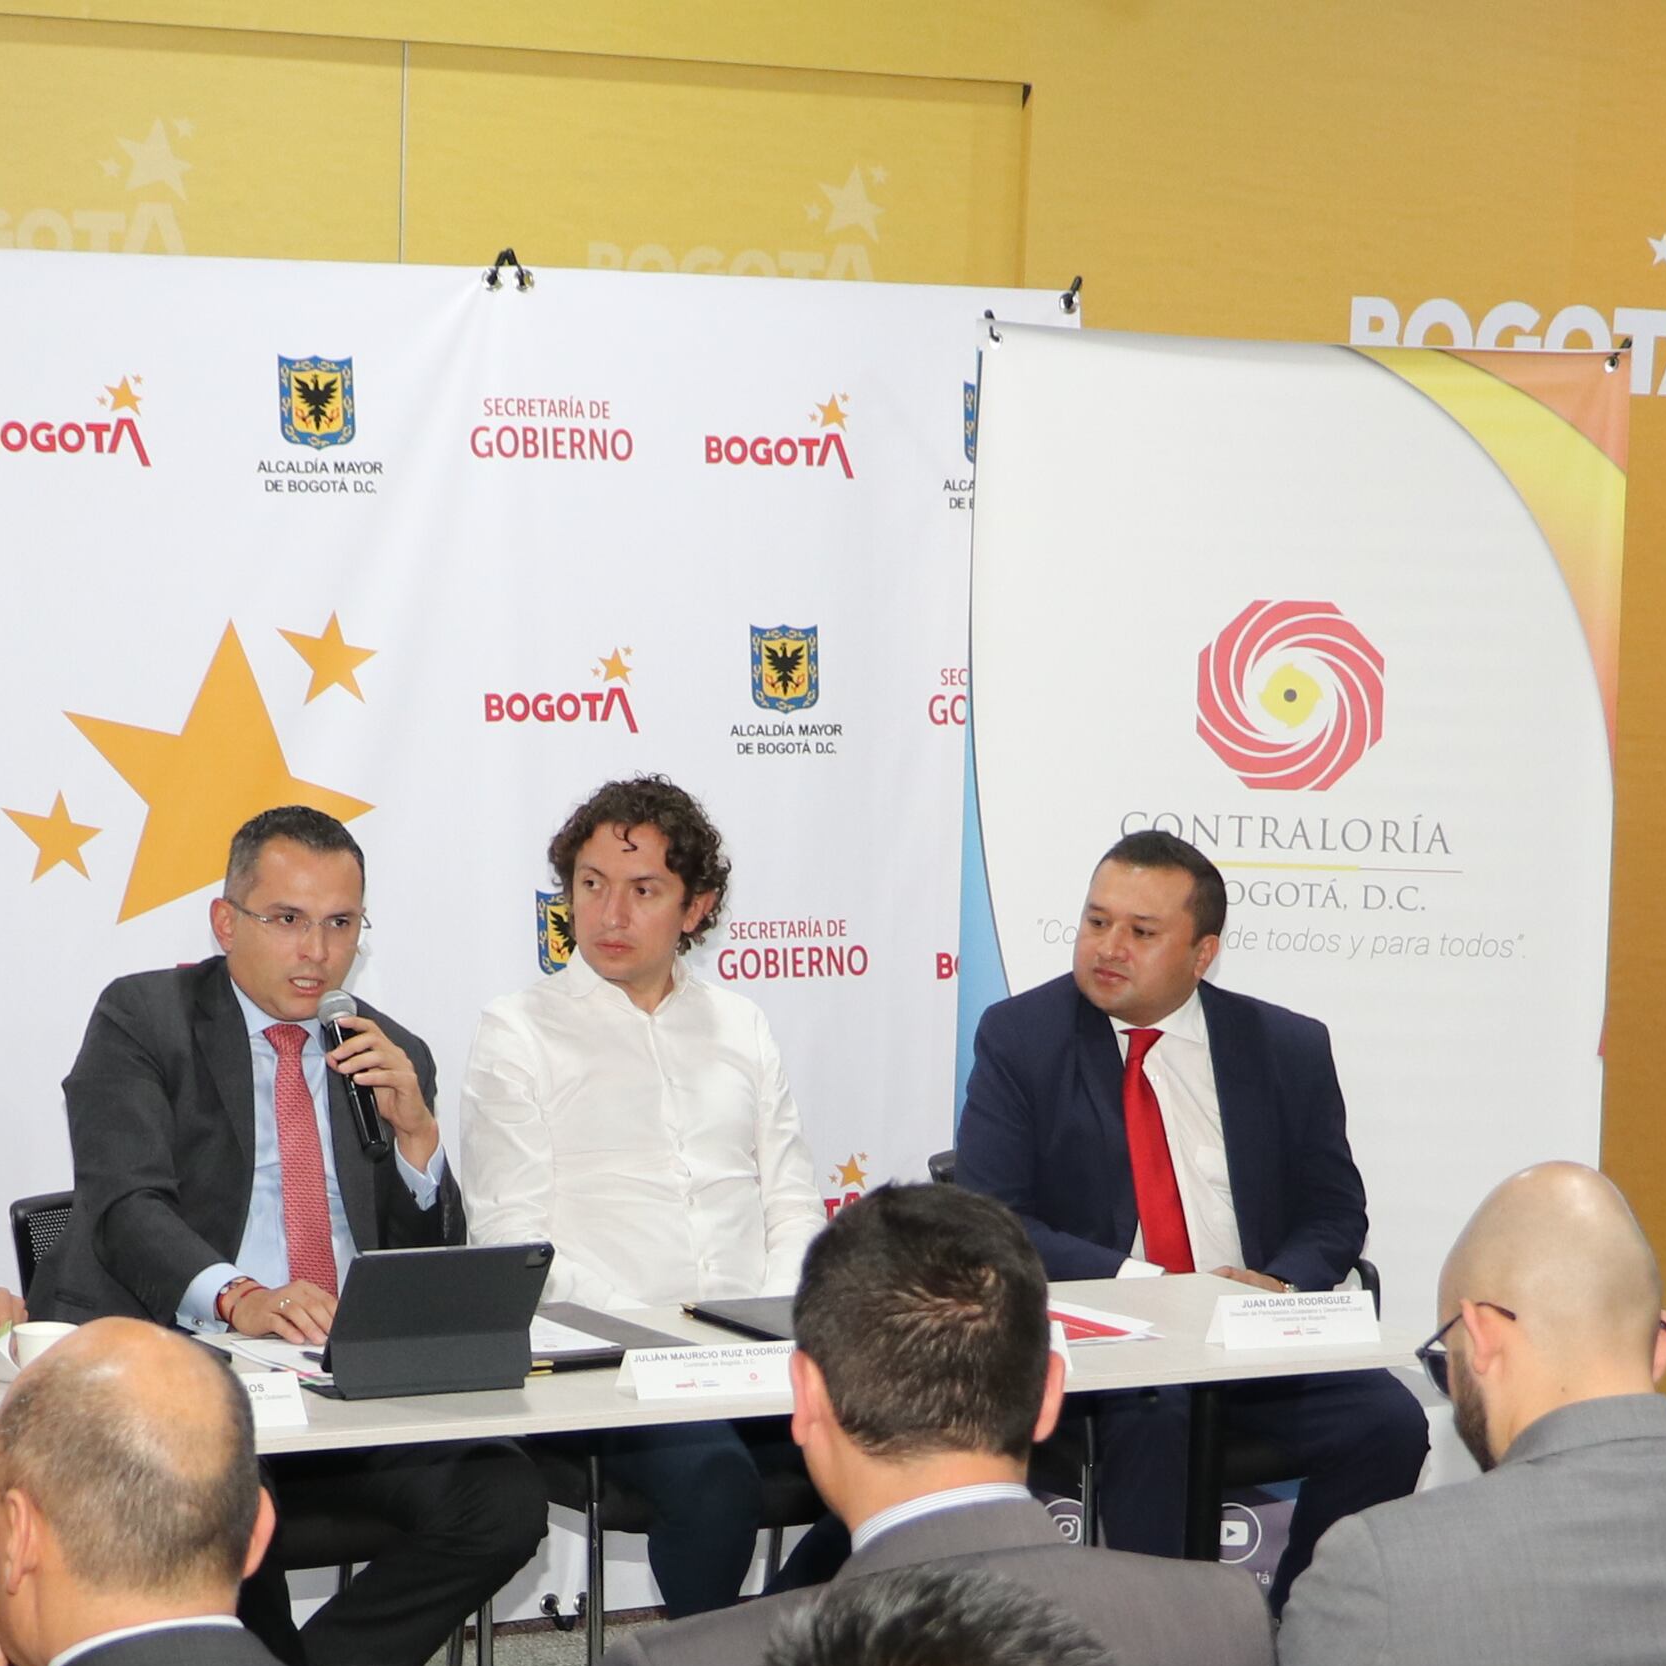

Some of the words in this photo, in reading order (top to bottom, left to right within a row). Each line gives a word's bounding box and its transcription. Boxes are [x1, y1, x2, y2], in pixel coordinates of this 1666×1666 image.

[483, 395, 586, 419] SECRETARÍA
[590, 400, 611, 419] DE
[470, 426, 633, 462] GOBIERNO
[257, 457, 329, 474] ALCALDÍA
[333, 460, 383, 475] MAYOR
[265, 479, 284, 493] DE
[288, 475, 348, 493] BOGOTÁ
[353, 480, 378, 494] D.C.
[949, 497, 965, 509] DE
[730, 721, 794, 737] ALCALDÍA
[798, 723, 843, 737] MAYOR
[737, 743, 754, 755] DE
[757, 738, 811, 755] BOGOTÁ
[815, 742, 837, 755] D.C.
[1120, 811, 1453, 856] CONTRALORÍA
[1362, 885, 1427, 912] D.C.
[729, 915, 823, 940] SECRETARÍA
[827, 919, 847, 937] DE
[1226, 924, 1258, 951] de
[1266, 926, 1341, 953] todos
[1347, 935, 1364, 959] y
[1372, 934, 1430, 959] para
[717, 945, 869, 980] GOBIERNO
[1242, 1299, 1266, 1309] JUAN
[1269, 1298, 1295, 1307] DAVID
[1298, 1295, 1351, 1306] RODRÍGUEZ
[670, 1351, 718, 1361] MAURICIO
[721, 1349, 743, 1358] RUIZ
